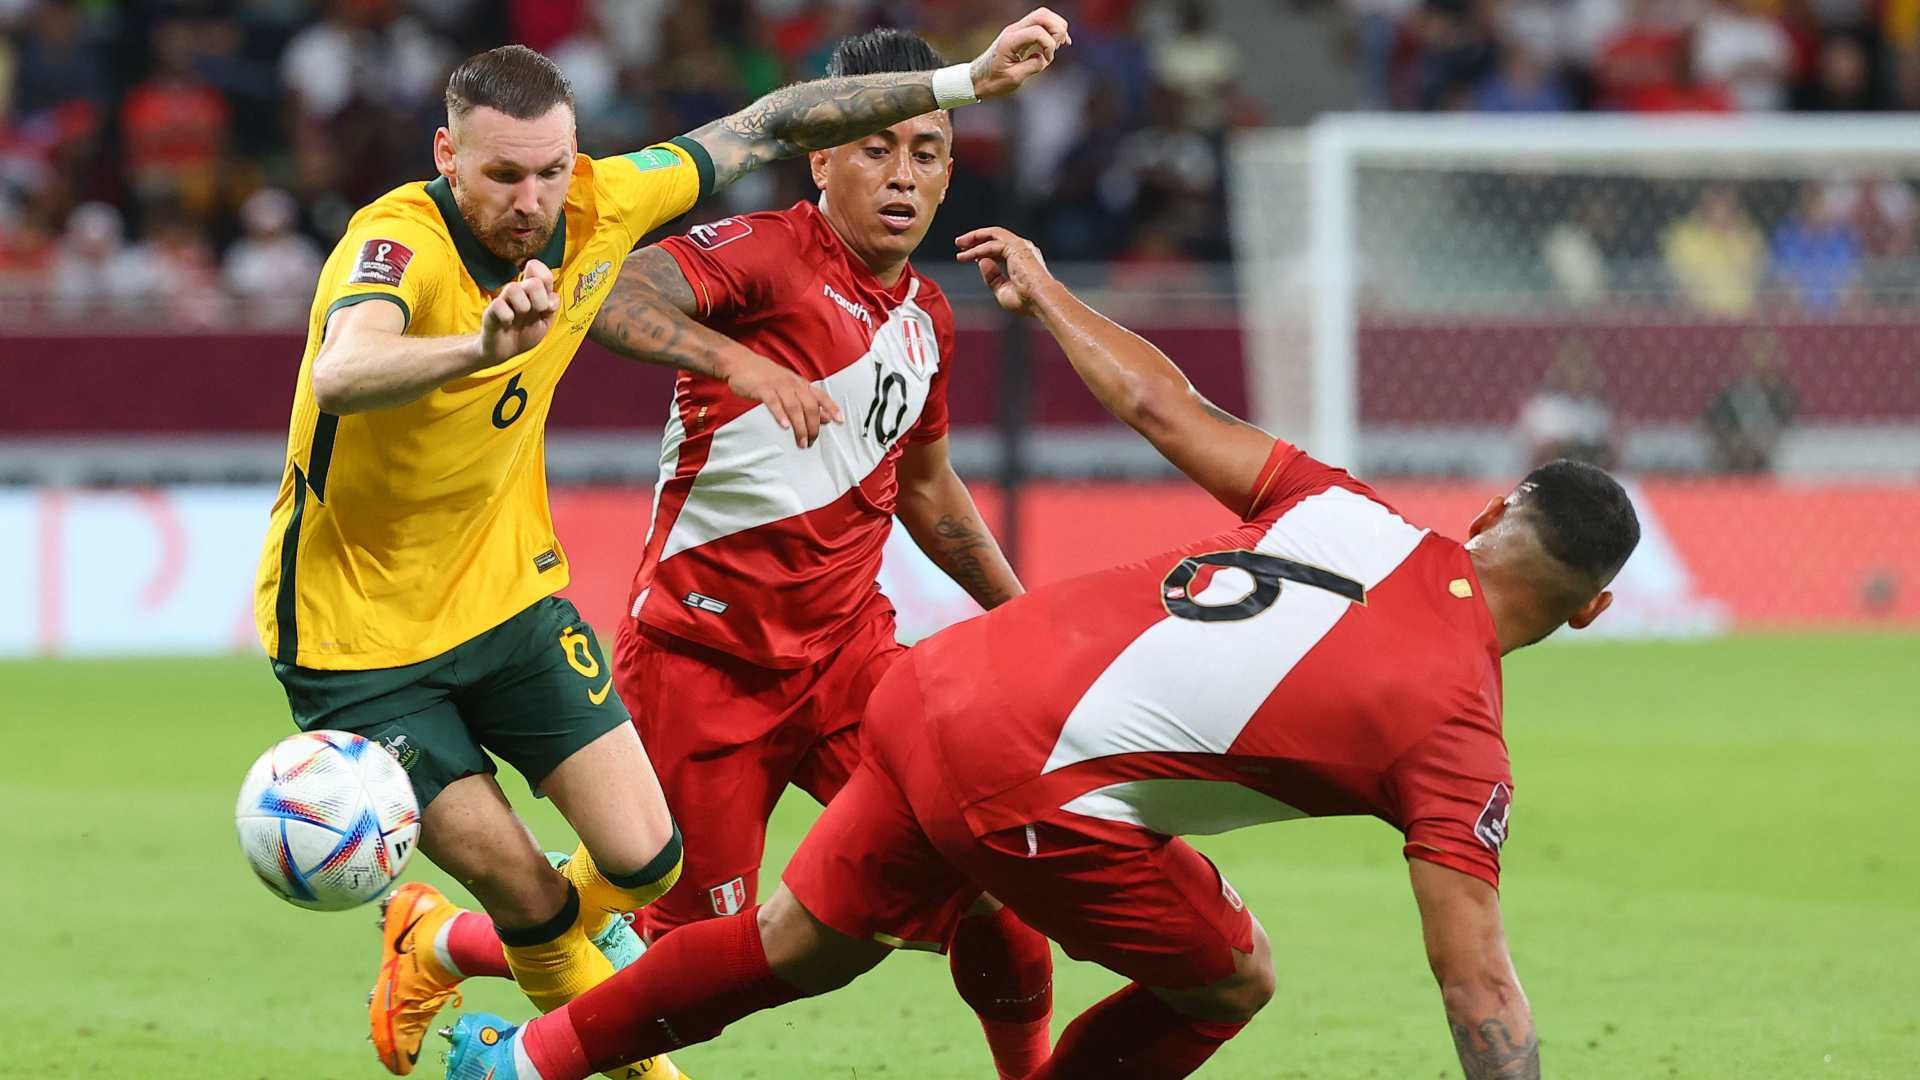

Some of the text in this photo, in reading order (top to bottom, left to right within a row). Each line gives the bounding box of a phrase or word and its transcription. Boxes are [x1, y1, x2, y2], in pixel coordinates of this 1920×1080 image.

[492, 371, 528, 430] 6
[862, 360, 908, 446] 10
[559, 626, 600, 679] 6
